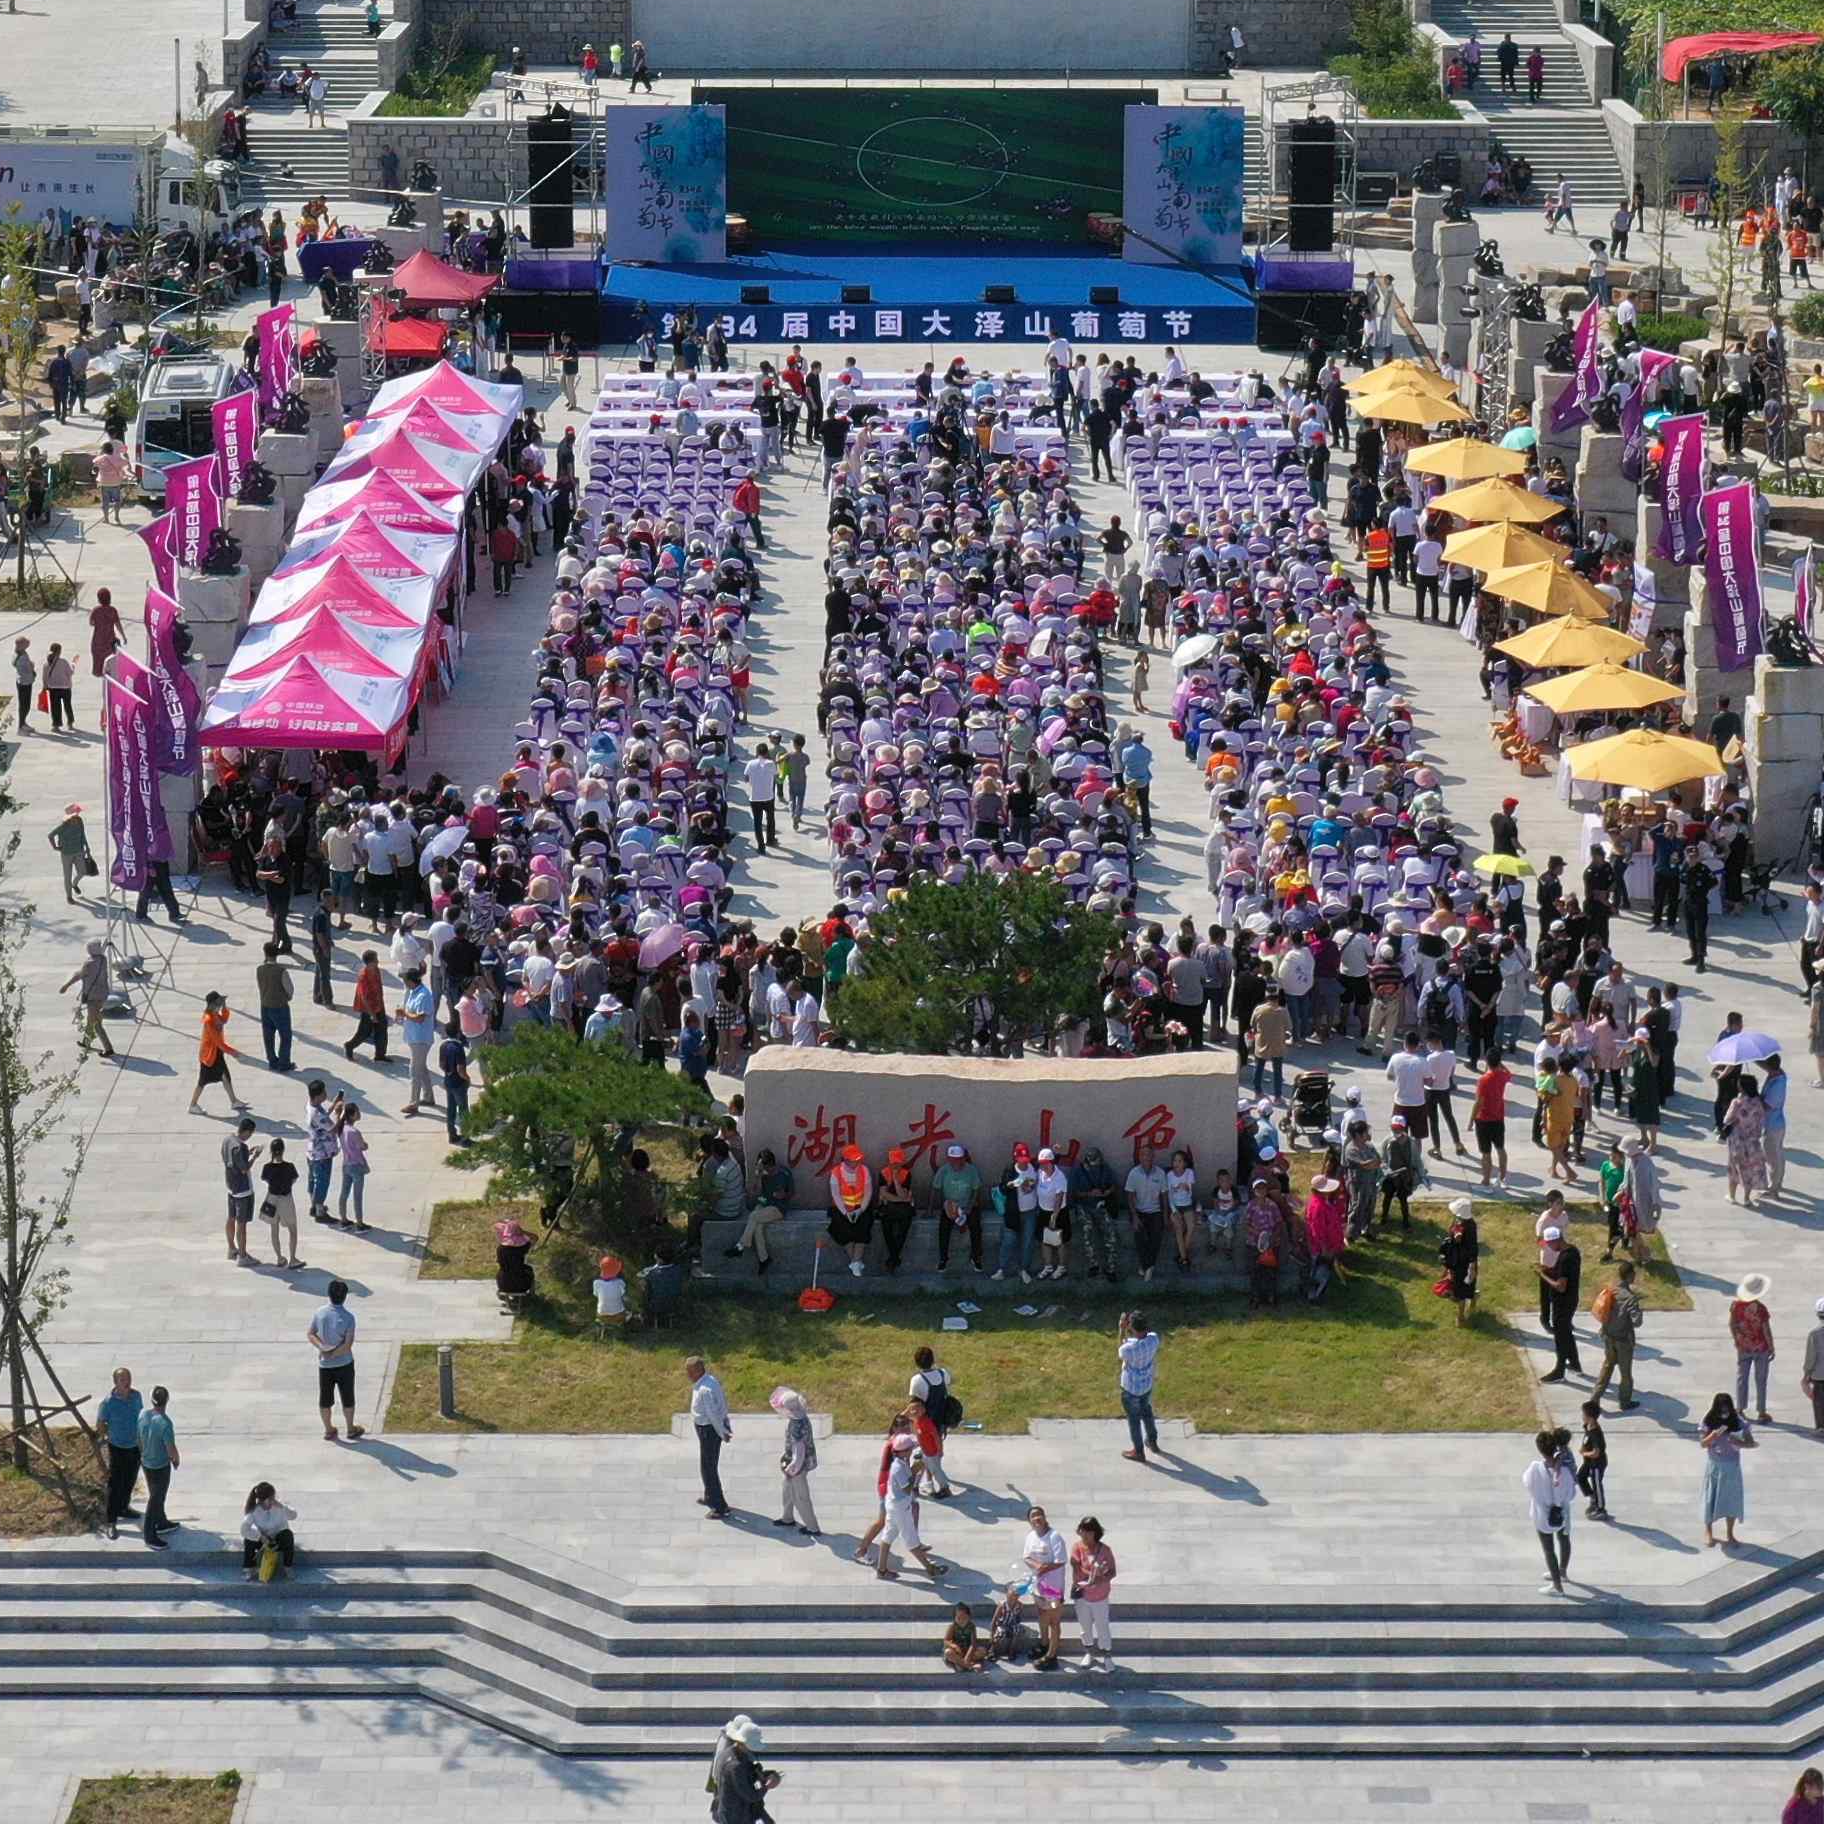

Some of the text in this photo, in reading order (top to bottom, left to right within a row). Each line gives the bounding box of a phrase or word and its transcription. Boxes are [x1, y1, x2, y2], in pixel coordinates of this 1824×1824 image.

[20, 182, 96, 194] 让未来生长
[1717, 501, 1747, 655] 第34届中国大泽山葡萄节
[787, 1102, 1197, 1178] 湖光山色
